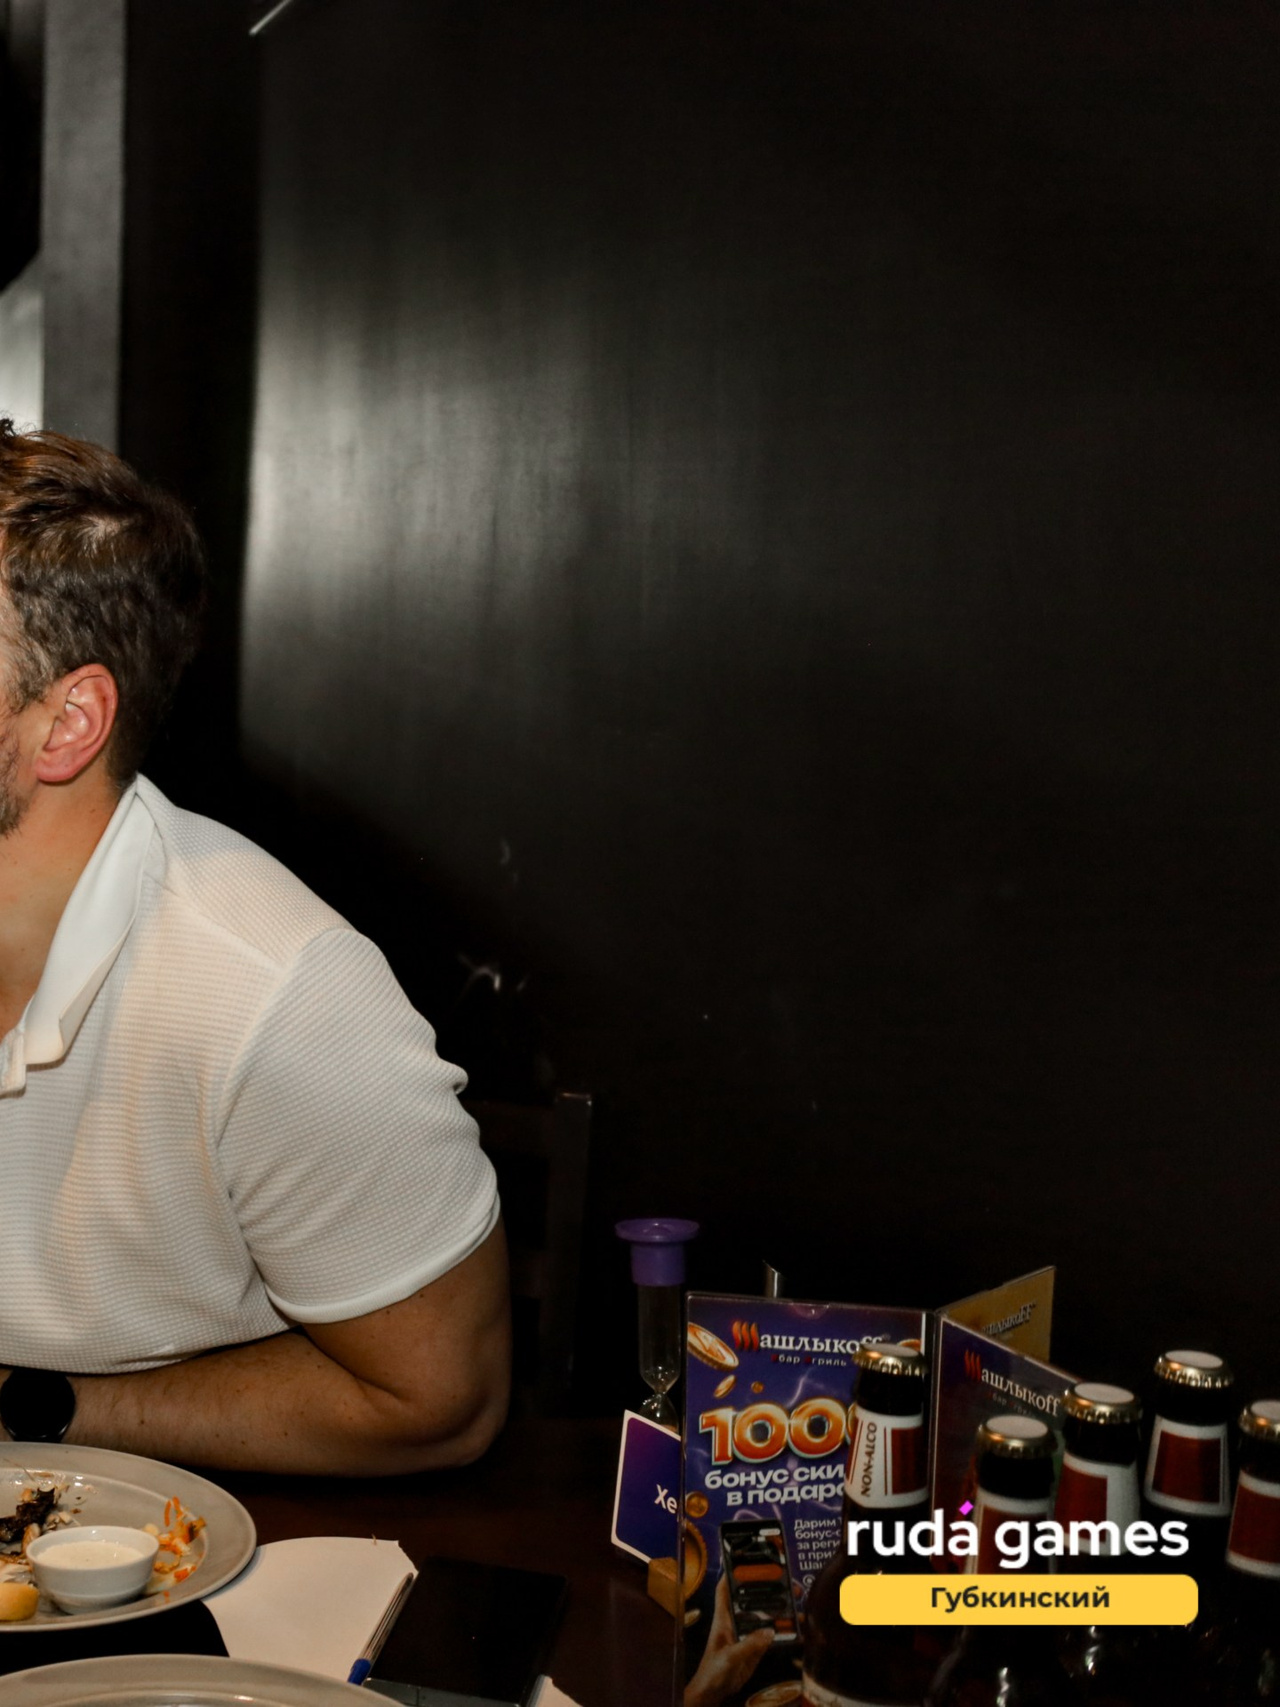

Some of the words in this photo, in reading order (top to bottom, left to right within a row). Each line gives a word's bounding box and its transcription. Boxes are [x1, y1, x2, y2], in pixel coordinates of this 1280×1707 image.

[699, 1398, 855, 1466] 100
[860, 1421, 878, 1498] NON-ALCO
[705, 1467, 790, 1490] бонус
[726, 1492, 744, 1507] в
[794, 1519, 837, 1531] Дарим
[797, 1541, 810, 1550] за
